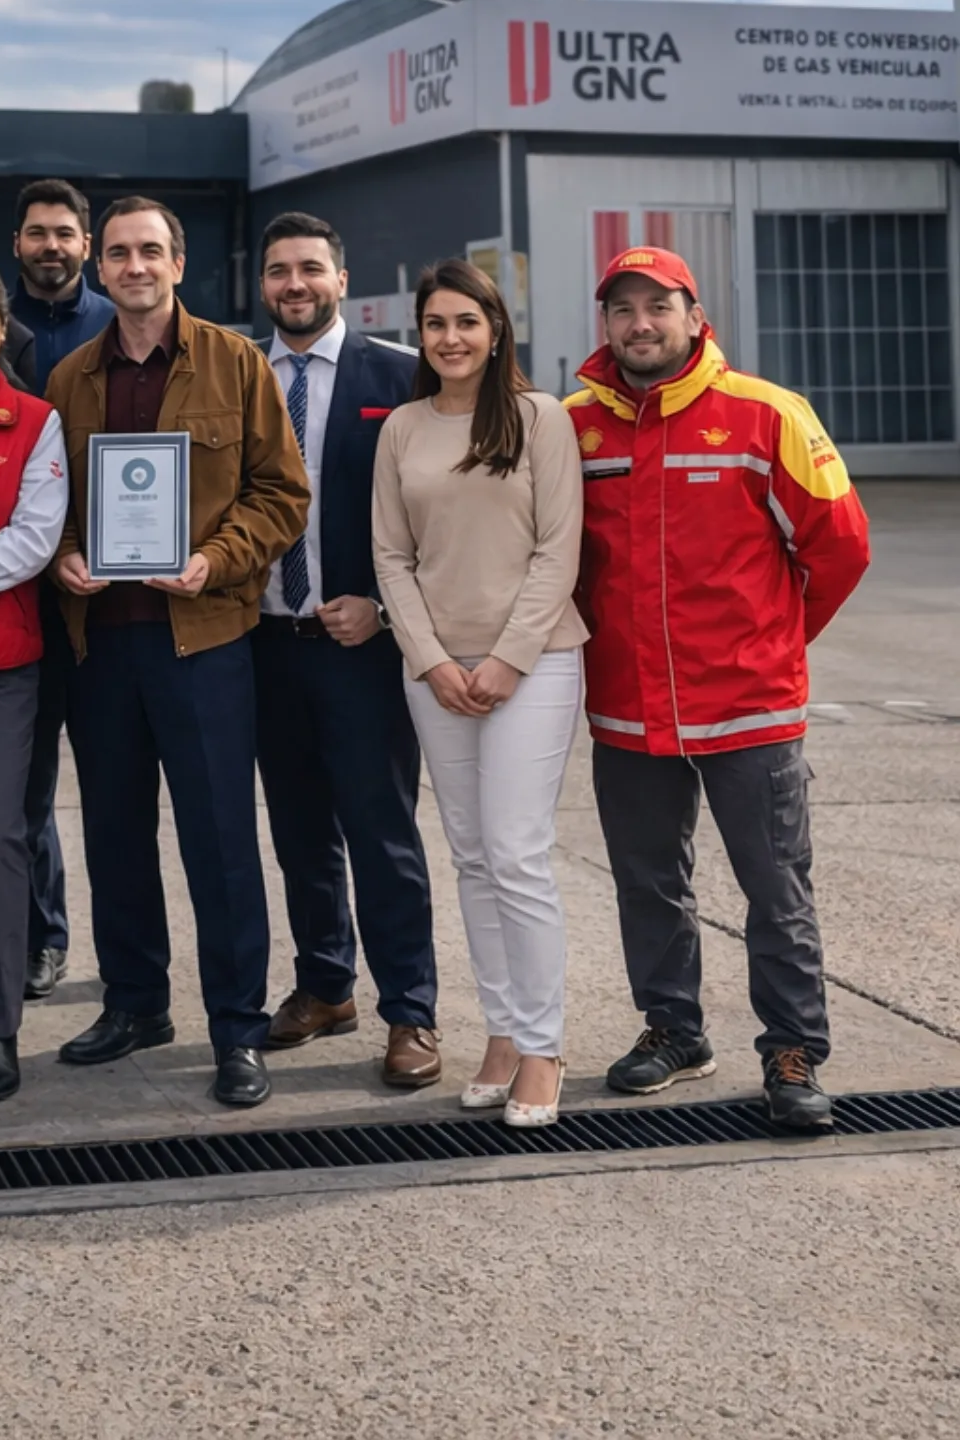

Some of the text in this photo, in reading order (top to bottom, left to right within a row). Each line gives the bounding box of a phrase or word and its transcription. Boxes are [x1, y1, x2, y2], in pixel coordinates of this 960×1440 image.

[557, 29, 681, 63] ULTRA
[735, 28, 809, 46] CENTRO
[815, 30, 839, 47] DE
[408, 38, 459, 81] ULTRA
[763, 56, 788, 73] DE
[794, 56, 831, 74] GAS
[414, 74, 453, 114] GNC
[572, 65, 668, 101] GNC
[738, 94, 781, 107] VENTA
